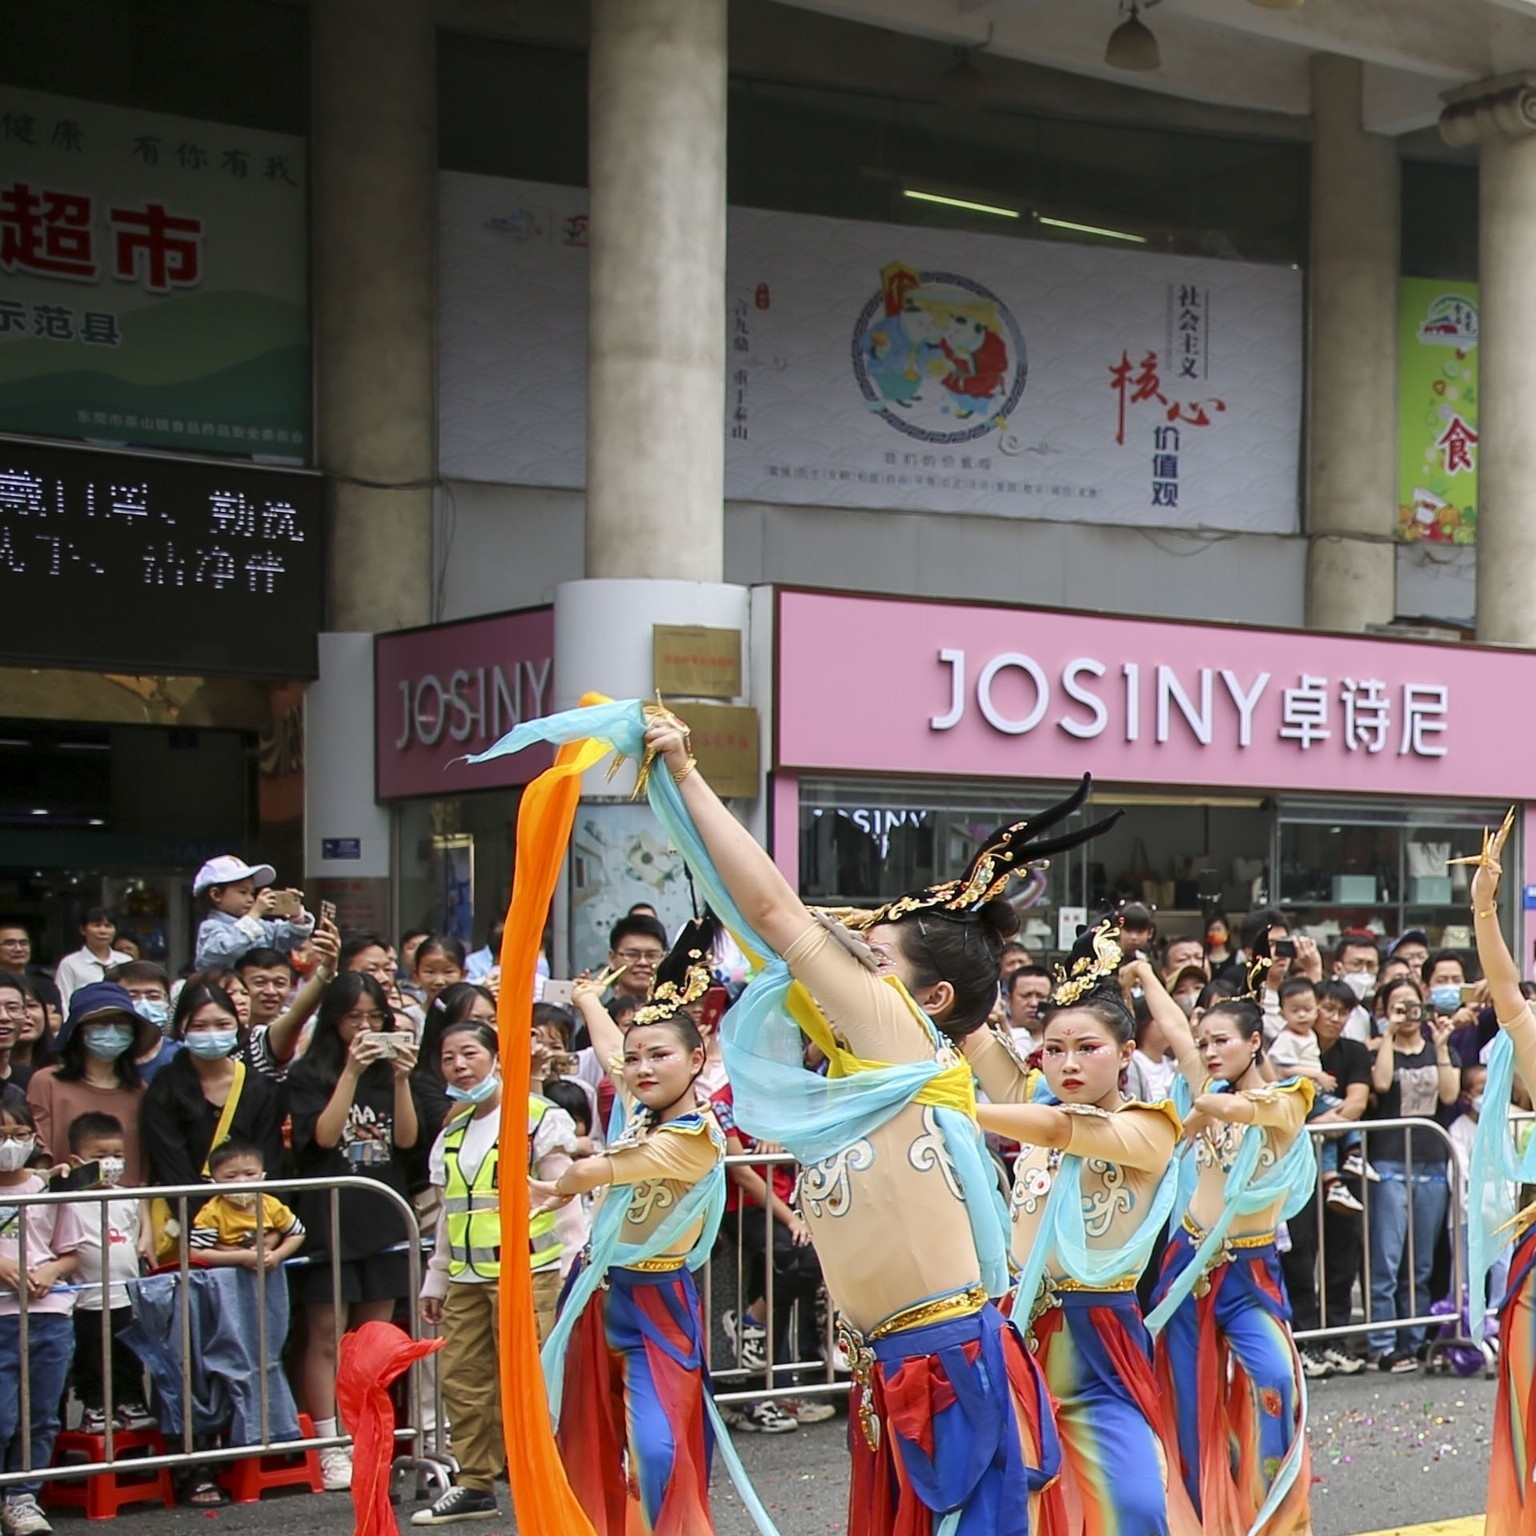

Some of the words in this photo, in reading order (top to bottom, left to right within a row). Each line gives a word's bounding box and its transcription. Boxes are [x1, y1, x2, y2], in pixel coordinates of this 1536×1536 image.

[131, 134, 299, 188] 有你有我
[0, 181, 202, 289] 超市
[1178, 284, 1203, 380] 社会主义
[1107, 348, 1227, 446] 核心
[1151, 425, 1181, 508] 价值观
[395, 657, 552, 751] JOSINY
[929, 648, 1272, 748] JOSINY
[1280, 674, 1450, 757] 卓诗尼
